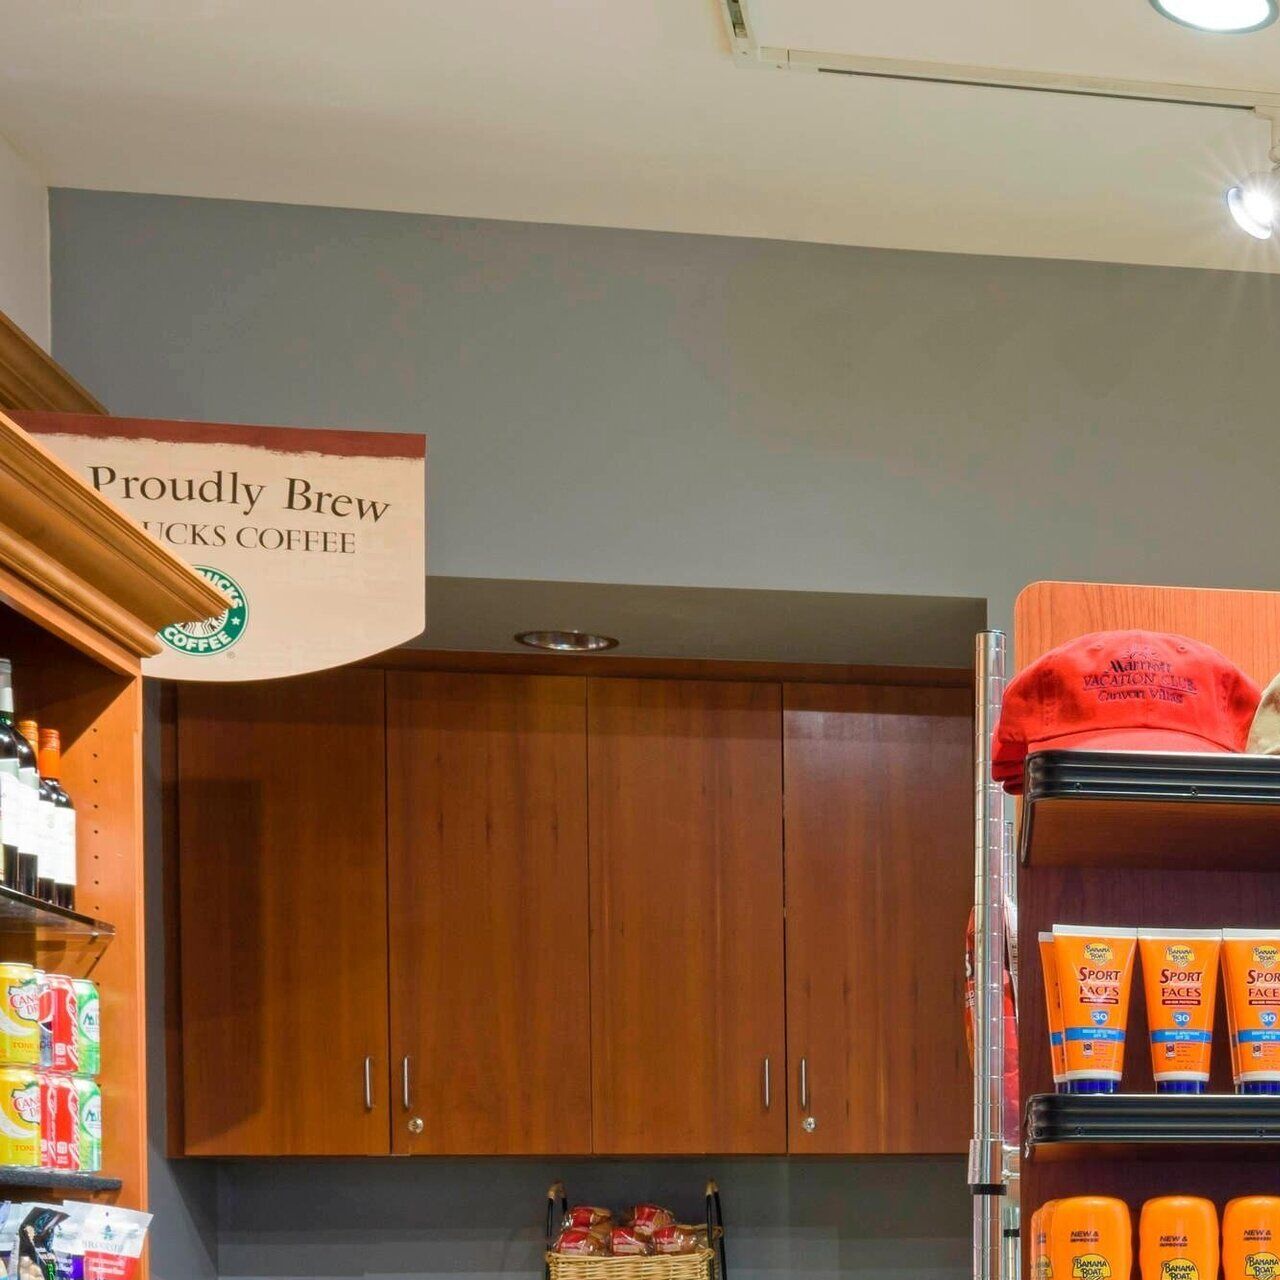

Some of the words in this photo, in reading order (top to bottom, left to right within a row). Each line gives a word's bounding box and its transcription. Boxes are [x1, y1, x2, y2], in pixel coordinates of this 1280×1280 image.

[87, 466, 266, 516] Proudly
[284, 477, 391, 523] Brew
[236, 527, 356, 554] COFFEE
[162, 626, 233, 652] COFFEE
[1078, 967, 1122, 982] SPORT
[1159, 968, 1202, 983] SPORT
[1079, 985, 1119, 997] FACES
[1161, 988, 1201, 998] FACES
[1092, 1012, 1108, 1021] 30
[1174, 1013, 1190, 1022] 30
[1261, 1014, 1276, 1022] 30
[1074, 1259, 1108, 1269] BANANA
[1081, 1268, 1102, 1277] BOAT
